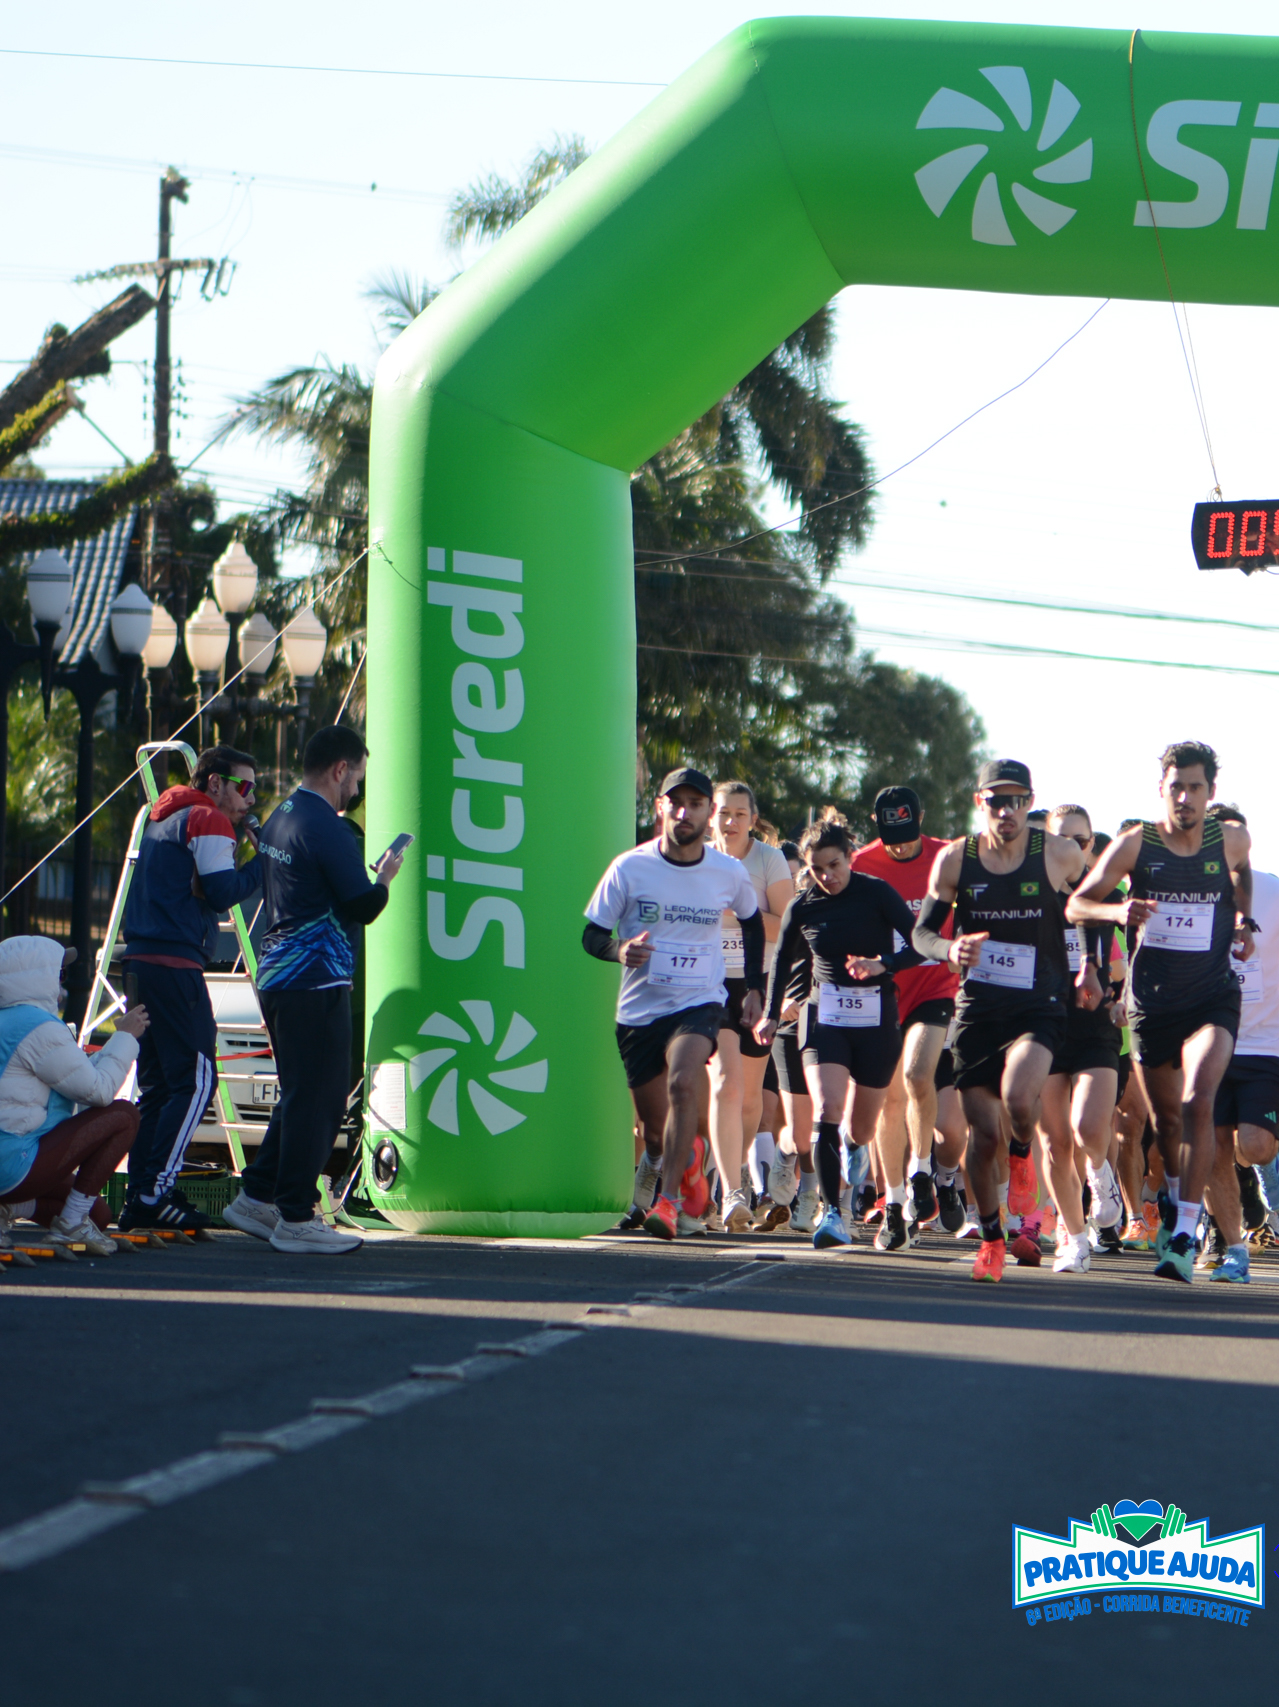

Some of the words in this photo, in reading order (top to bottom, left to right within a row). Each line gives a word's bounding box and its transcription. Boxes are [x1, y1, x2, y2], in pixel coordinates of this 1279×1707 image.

[427, 546, 525, 970] Sicredi
[258, 842, 292, 865] GANIZAÇÃO
[1146, 889, 1221, 903] TITANIUM
[970, 908, 1042, 920] TITANIUM
[1165, 916, 1194, 928] 174
[722, 940, 744, 949] 235
[670, 956, 698, 968] 177
[988, 954, 1015, 967] 145
[837, 998, 863, 1009] 135
